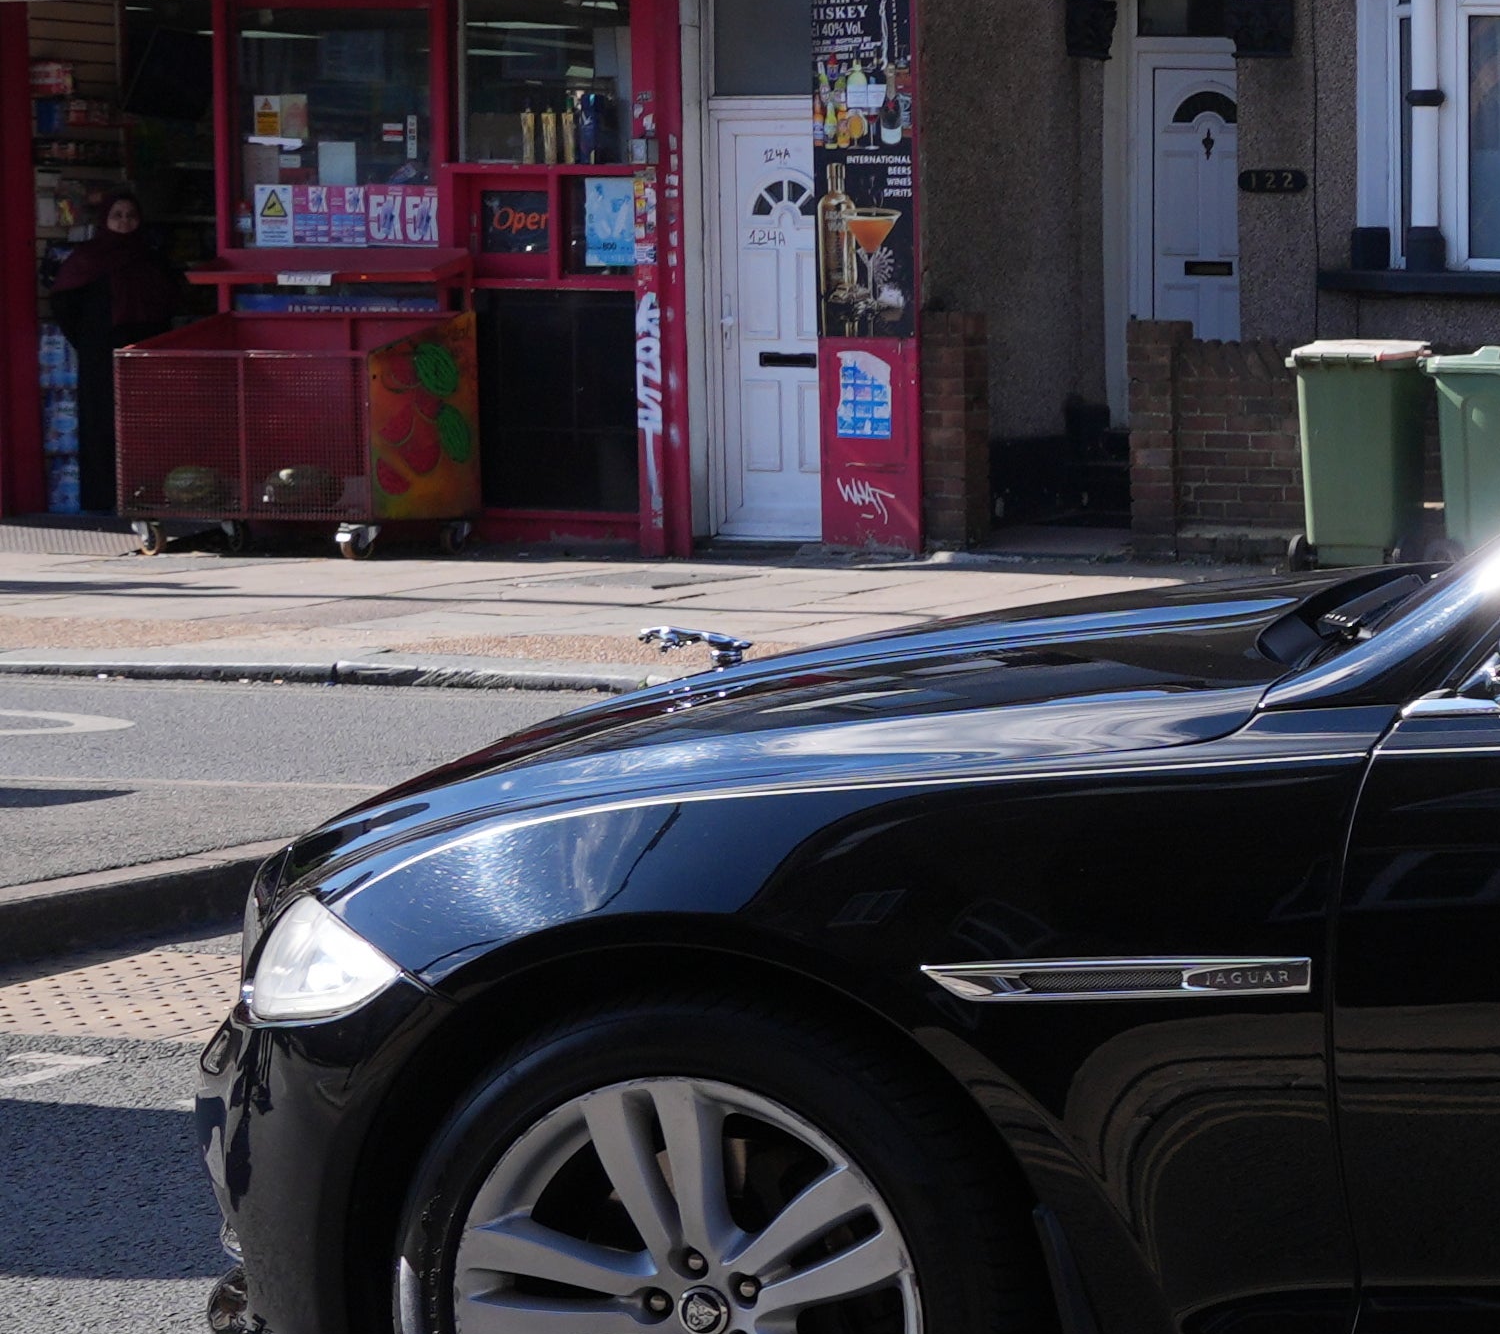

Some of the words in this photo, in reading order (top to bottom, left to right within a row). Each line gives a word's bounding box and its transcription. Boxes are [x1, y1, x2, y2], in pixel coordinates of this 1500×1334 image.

[821, 21, 845, 37] 40%
[763, 147, 791, 164] 124A
[846, 155, 911, 165] INTERNATIONAL
[887, 166, 912, 176] BEERS
[886, 176, 912, 186] WINES
[1250, 171, 1294, 189] 122
[883, 187, 912, 197] SPIRITS
[748, 229, 786, 246] 124A
[837, 477, 896, 525] WHAT
[1205, 970, 1290, 986] JAGUAR
